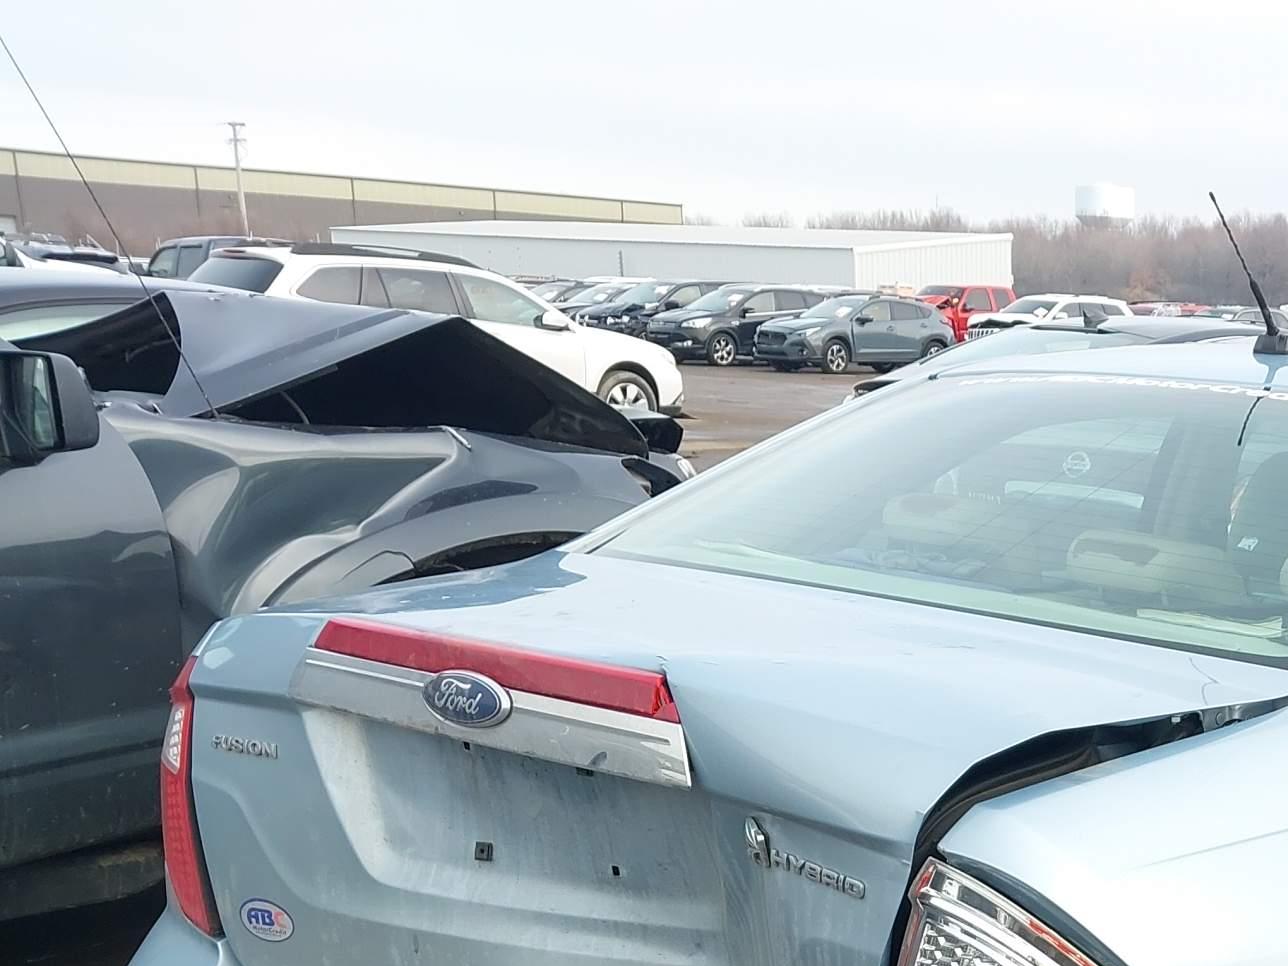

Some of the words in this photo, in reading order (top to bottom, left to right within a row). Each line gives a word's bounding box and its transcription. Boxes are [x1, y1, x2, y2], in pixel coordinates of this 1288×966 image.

[434, 678, 483, 715] Ford
[211, 735, 279, 760] FUSION
[770, 848, 866, 900] HYBRID
